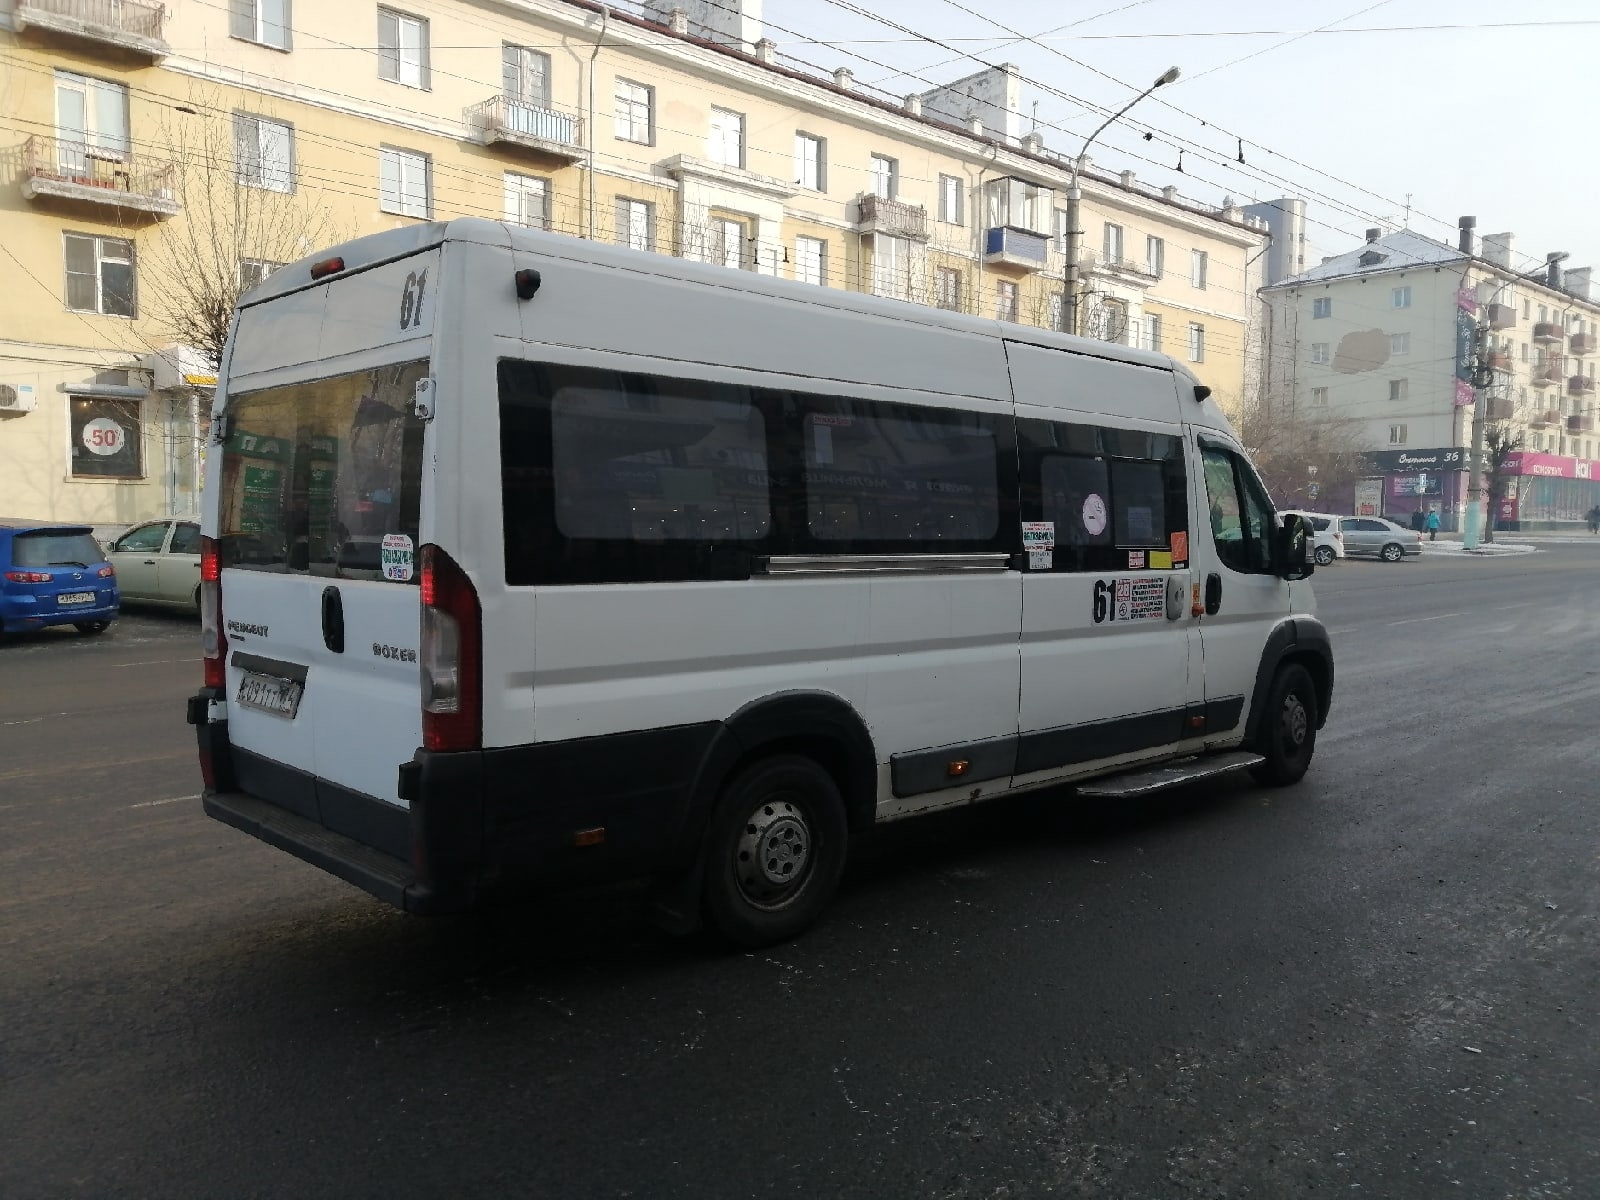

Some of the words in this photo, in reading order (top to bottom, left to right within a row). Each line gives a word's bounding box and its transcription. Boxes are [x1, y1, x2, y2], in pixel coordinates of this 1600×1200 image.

[400, 267, 427, 331] 61
[1093, 579, 1116, 623] 61
[228, 620, 269, 638] PEUGEOT
[372, 642, 417, 664] BOXER
